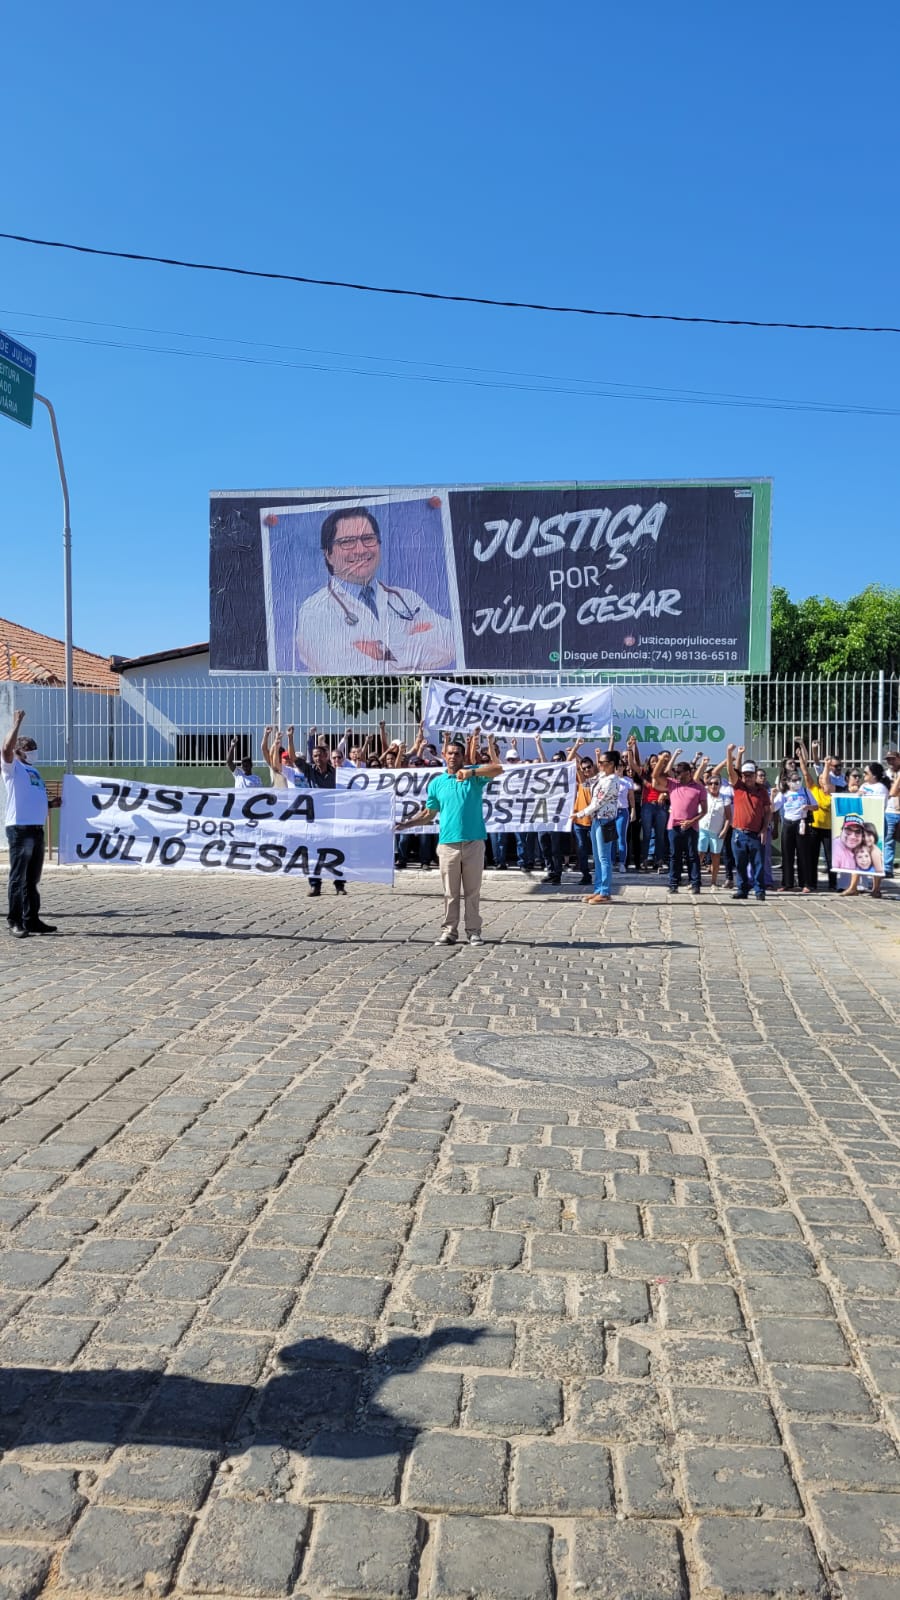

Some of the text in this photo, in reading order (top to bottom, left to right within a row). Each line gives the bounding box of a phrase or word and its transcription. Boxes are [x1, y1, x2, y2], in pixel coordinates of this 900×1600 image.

[12, 347, 33, 368] JULHO
[473, 501, 668, 570] JUSTIÇA
[549, 565, 601, 592] POR
[471, 584, 684, 637] JÚLIO CÉSAR
[563, 650, 598, 662] Disque
[675, 650, 738, 661] 98136-6518
[444, 687, 537, 717] CHEGA
[548, 696, 583, 715] DE
[623, 707, 698, 720] MUNICIPAL
[434, 704, 593, 736] IMPUNIDADE
[627, 720, 726, 743] ARAÚJO
[92, 783, 315, 827] JUSTIÇA
[186, 818, 235, 837] POR
[76, 827, 345, 877] JÚLIO CESAR
